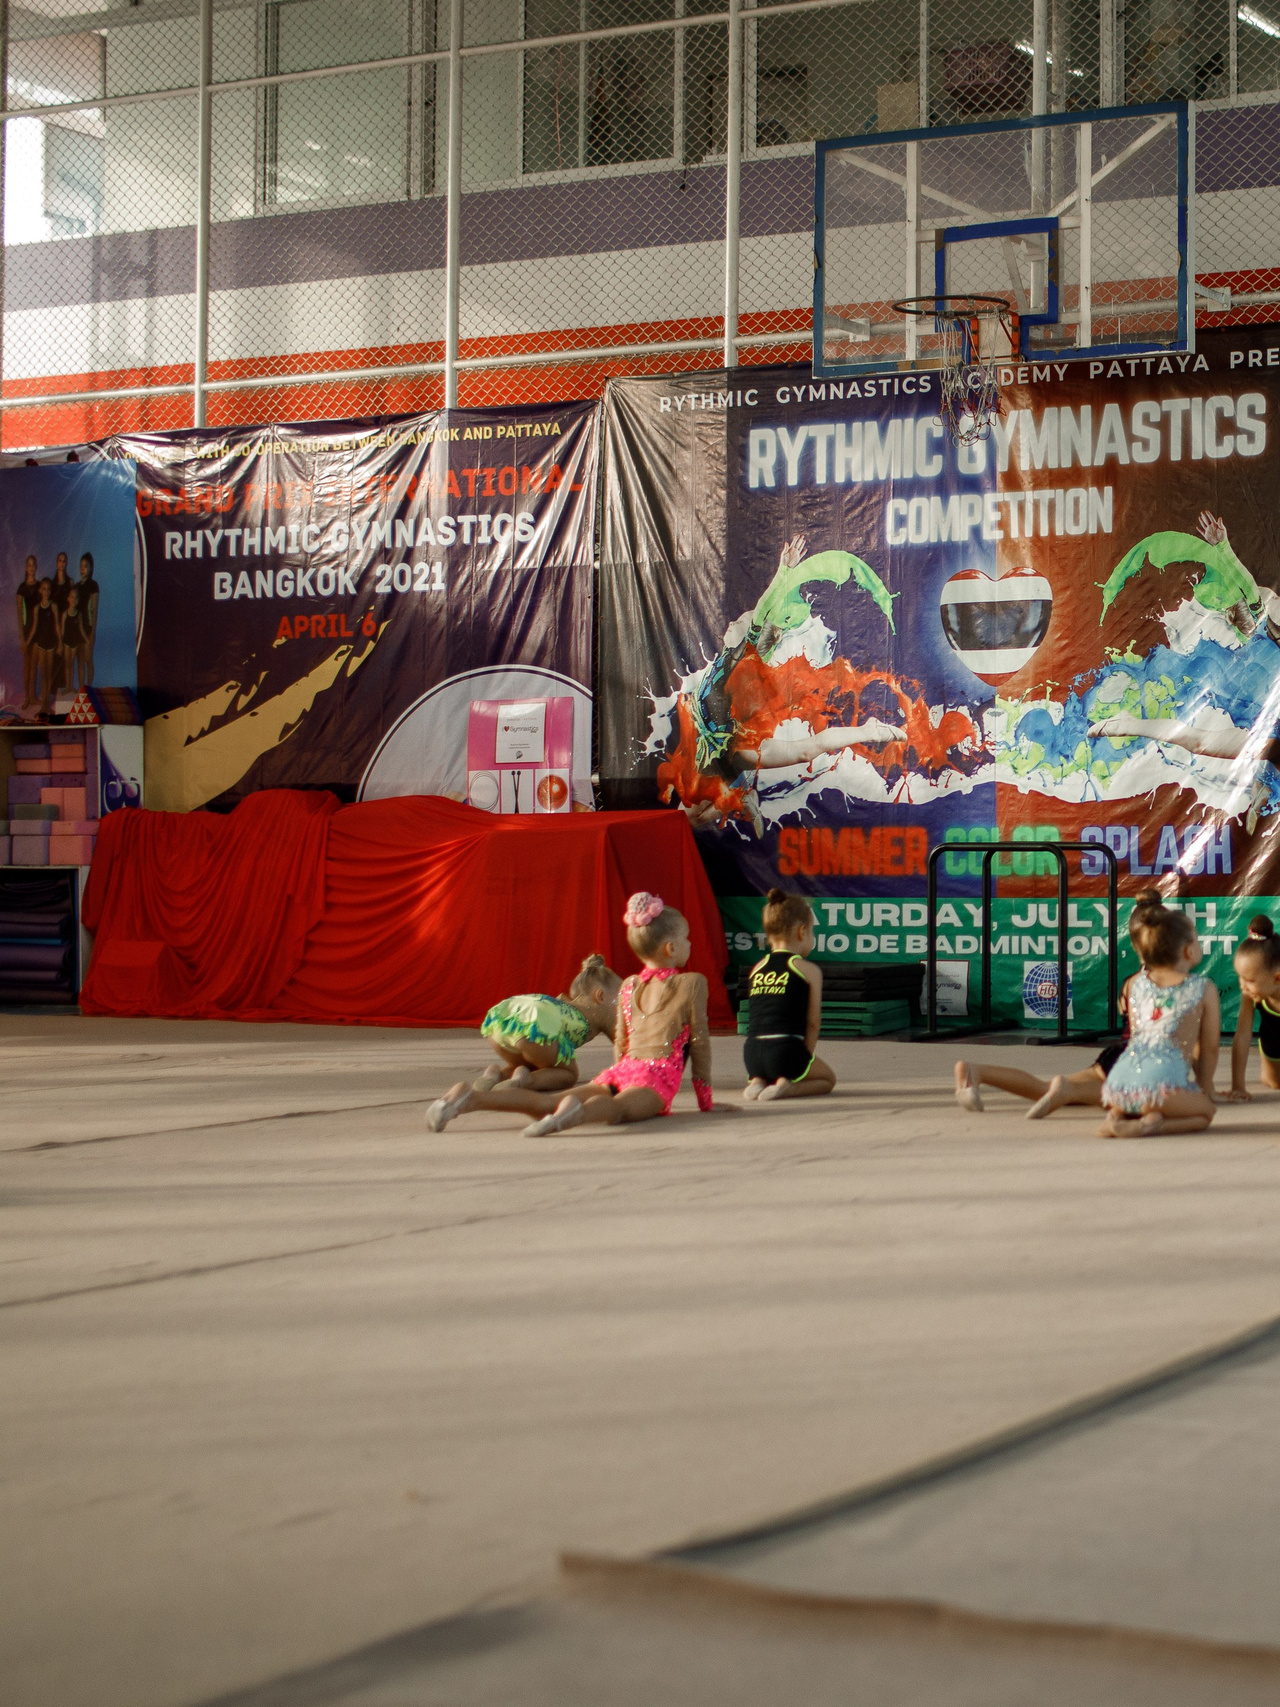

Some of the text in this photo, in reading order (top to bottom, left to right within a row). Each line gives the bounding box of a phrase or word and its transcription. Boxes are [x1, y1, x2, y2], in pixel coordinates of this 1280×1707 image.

[659, 389, 759, 413] RYTHMIC
[775, 375, 932, 404] GYMNASTICS
[1088, 354, 1210, 380] PATTAYA
[234, 441, 329, 458] COOPERATION
[333, 434, 396, 451] BETWEEN
[463, 426, 493, 440] AND
[497, 422, 562, 439] PATTAYA
[749, 392, 1268, 489] RYTHMIC GYMNASTICS
[136, 485, 234, 518] GRAND
[886, 486, 1113, 545] COMPETITION
[165, 512, 536, 559] RHYTHMIC GYMNASTICS
[213, 561, 446, 600] BANGKOK 2021
[276, 611, 377, 639] APRIL 6
[778, 825, 1232, 876] SUMMER COLOR SPLASH
[810, 902, 998, 930] TURDAY,
[1011, 902, 1123, 928] JULY
[857, 934, 899, 953] DE
[752, 971, 790, 987] RGA
